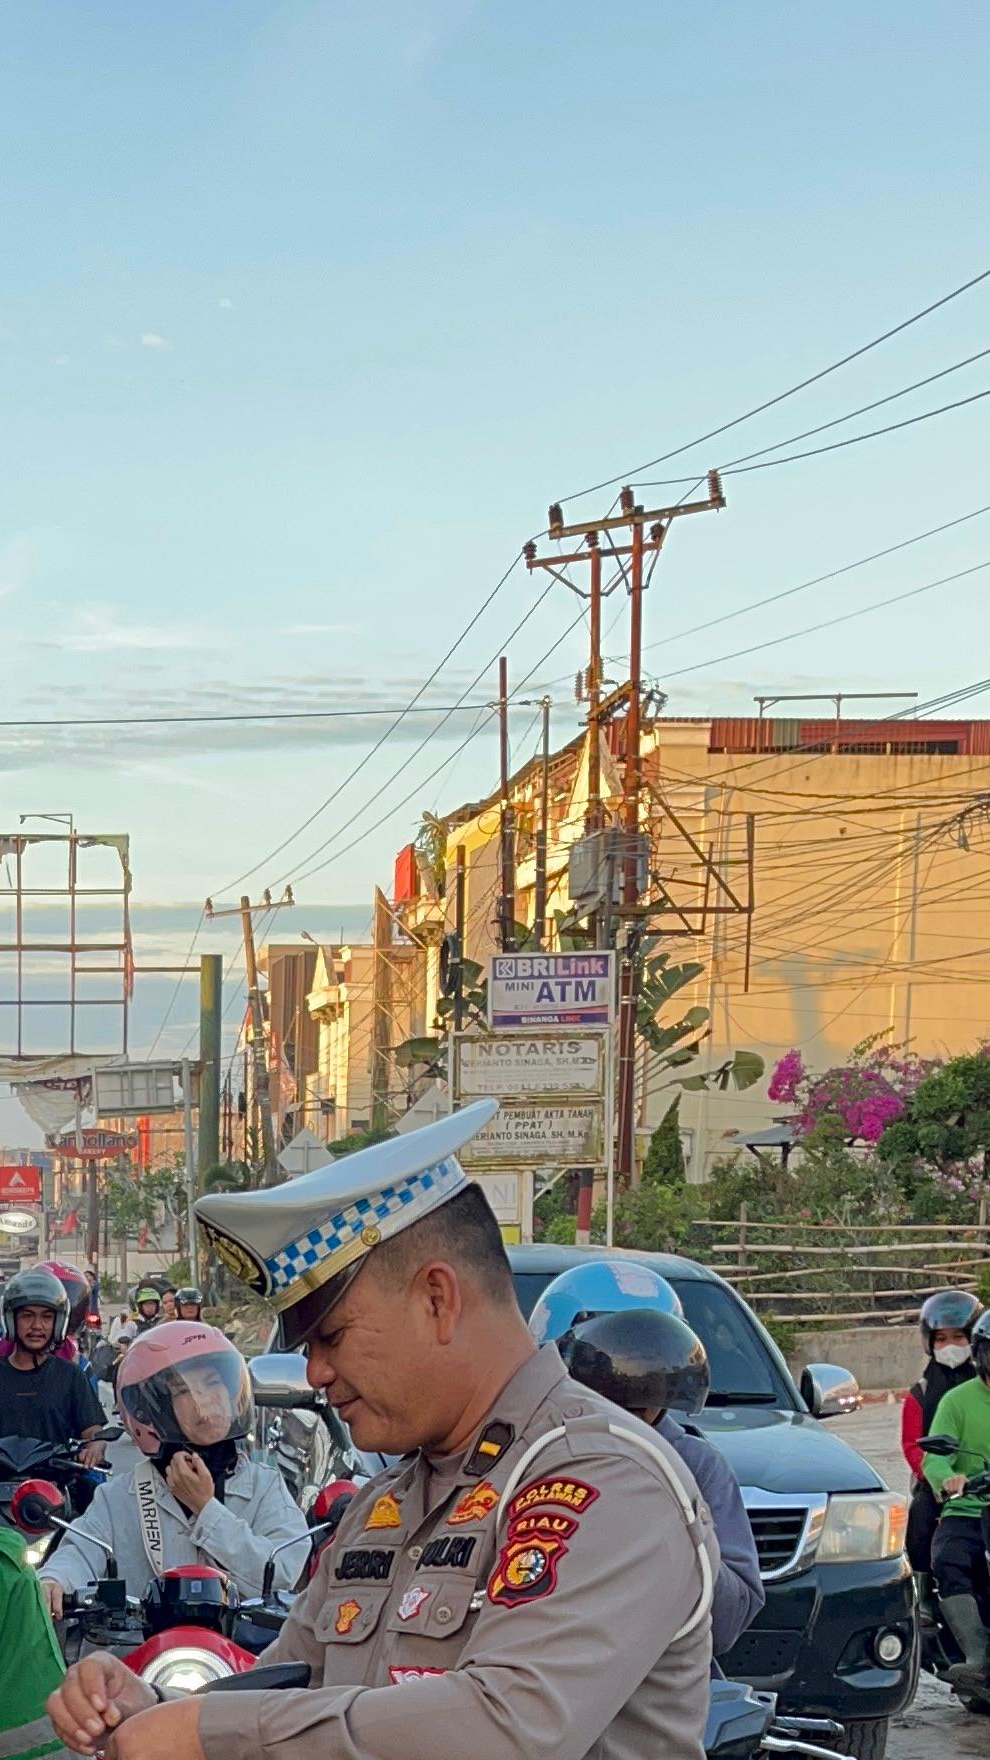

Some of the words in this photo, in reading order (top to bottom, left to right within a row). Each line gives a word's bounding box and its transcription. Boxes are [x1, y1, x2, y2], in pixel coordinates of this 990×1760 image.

[517, 958, 604, 977] BRILink
[505, 982, 534, 992] MINI
[536, 980, 597, 1003] ATM
[478, 1041, 583, 1057] NOTARIS
[504, 1110, 541, 1120] PEMBUAT
[544, 1110, 564, 1119] AKTA
[568, 1109, 594, 1119] TANAH
[516, 1516, 569, 1531] RIAU
